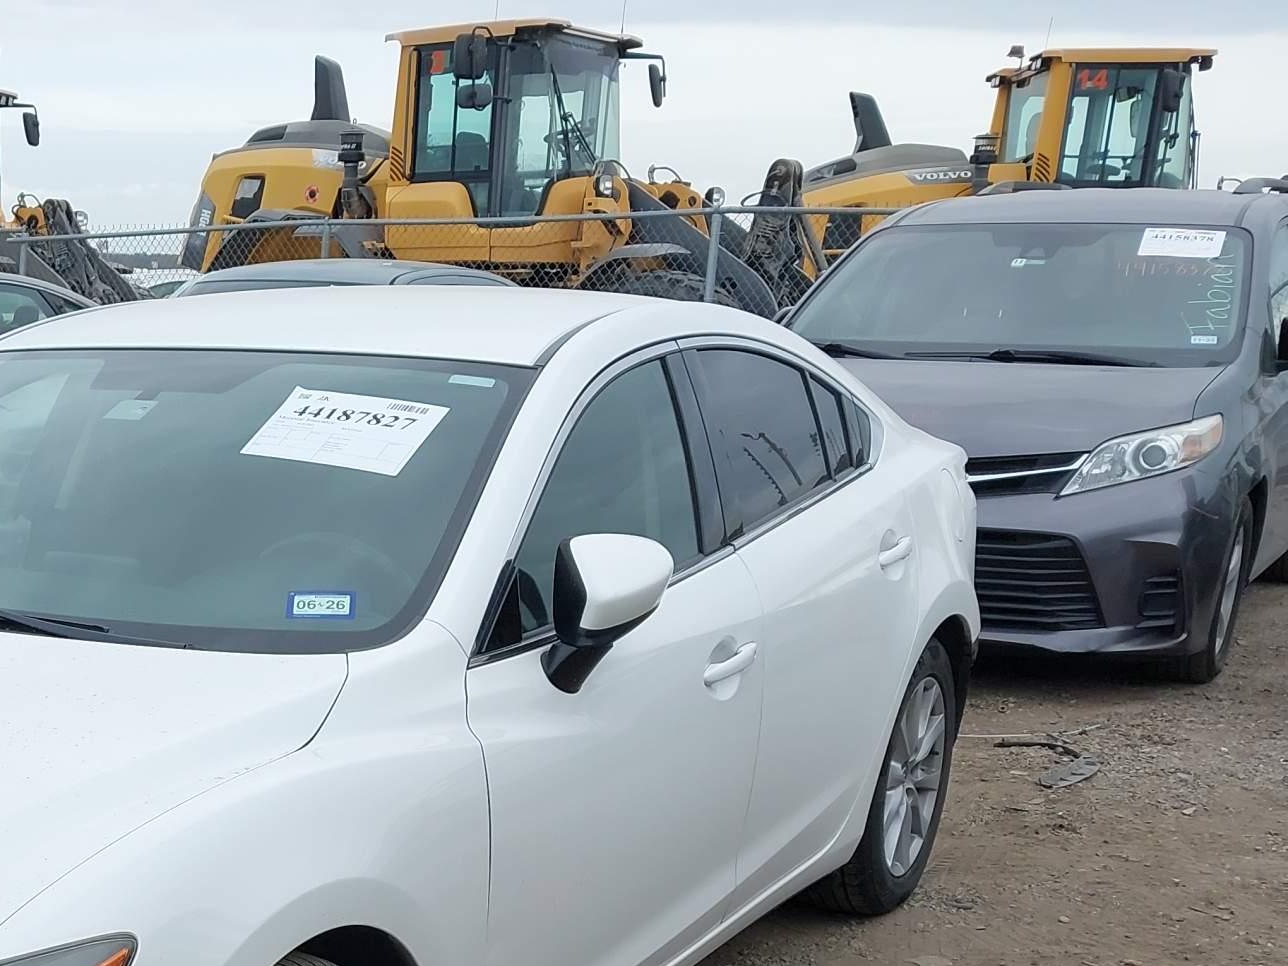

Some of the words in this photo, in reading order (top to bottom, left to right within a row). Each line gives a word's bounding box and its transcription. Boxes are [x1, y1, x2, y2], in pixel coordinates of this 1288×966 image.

[1079, 69, 1108, 90] 14
[914, 170, 972, 181] VOLVO
[293, 404, 419, 431] 44187827
